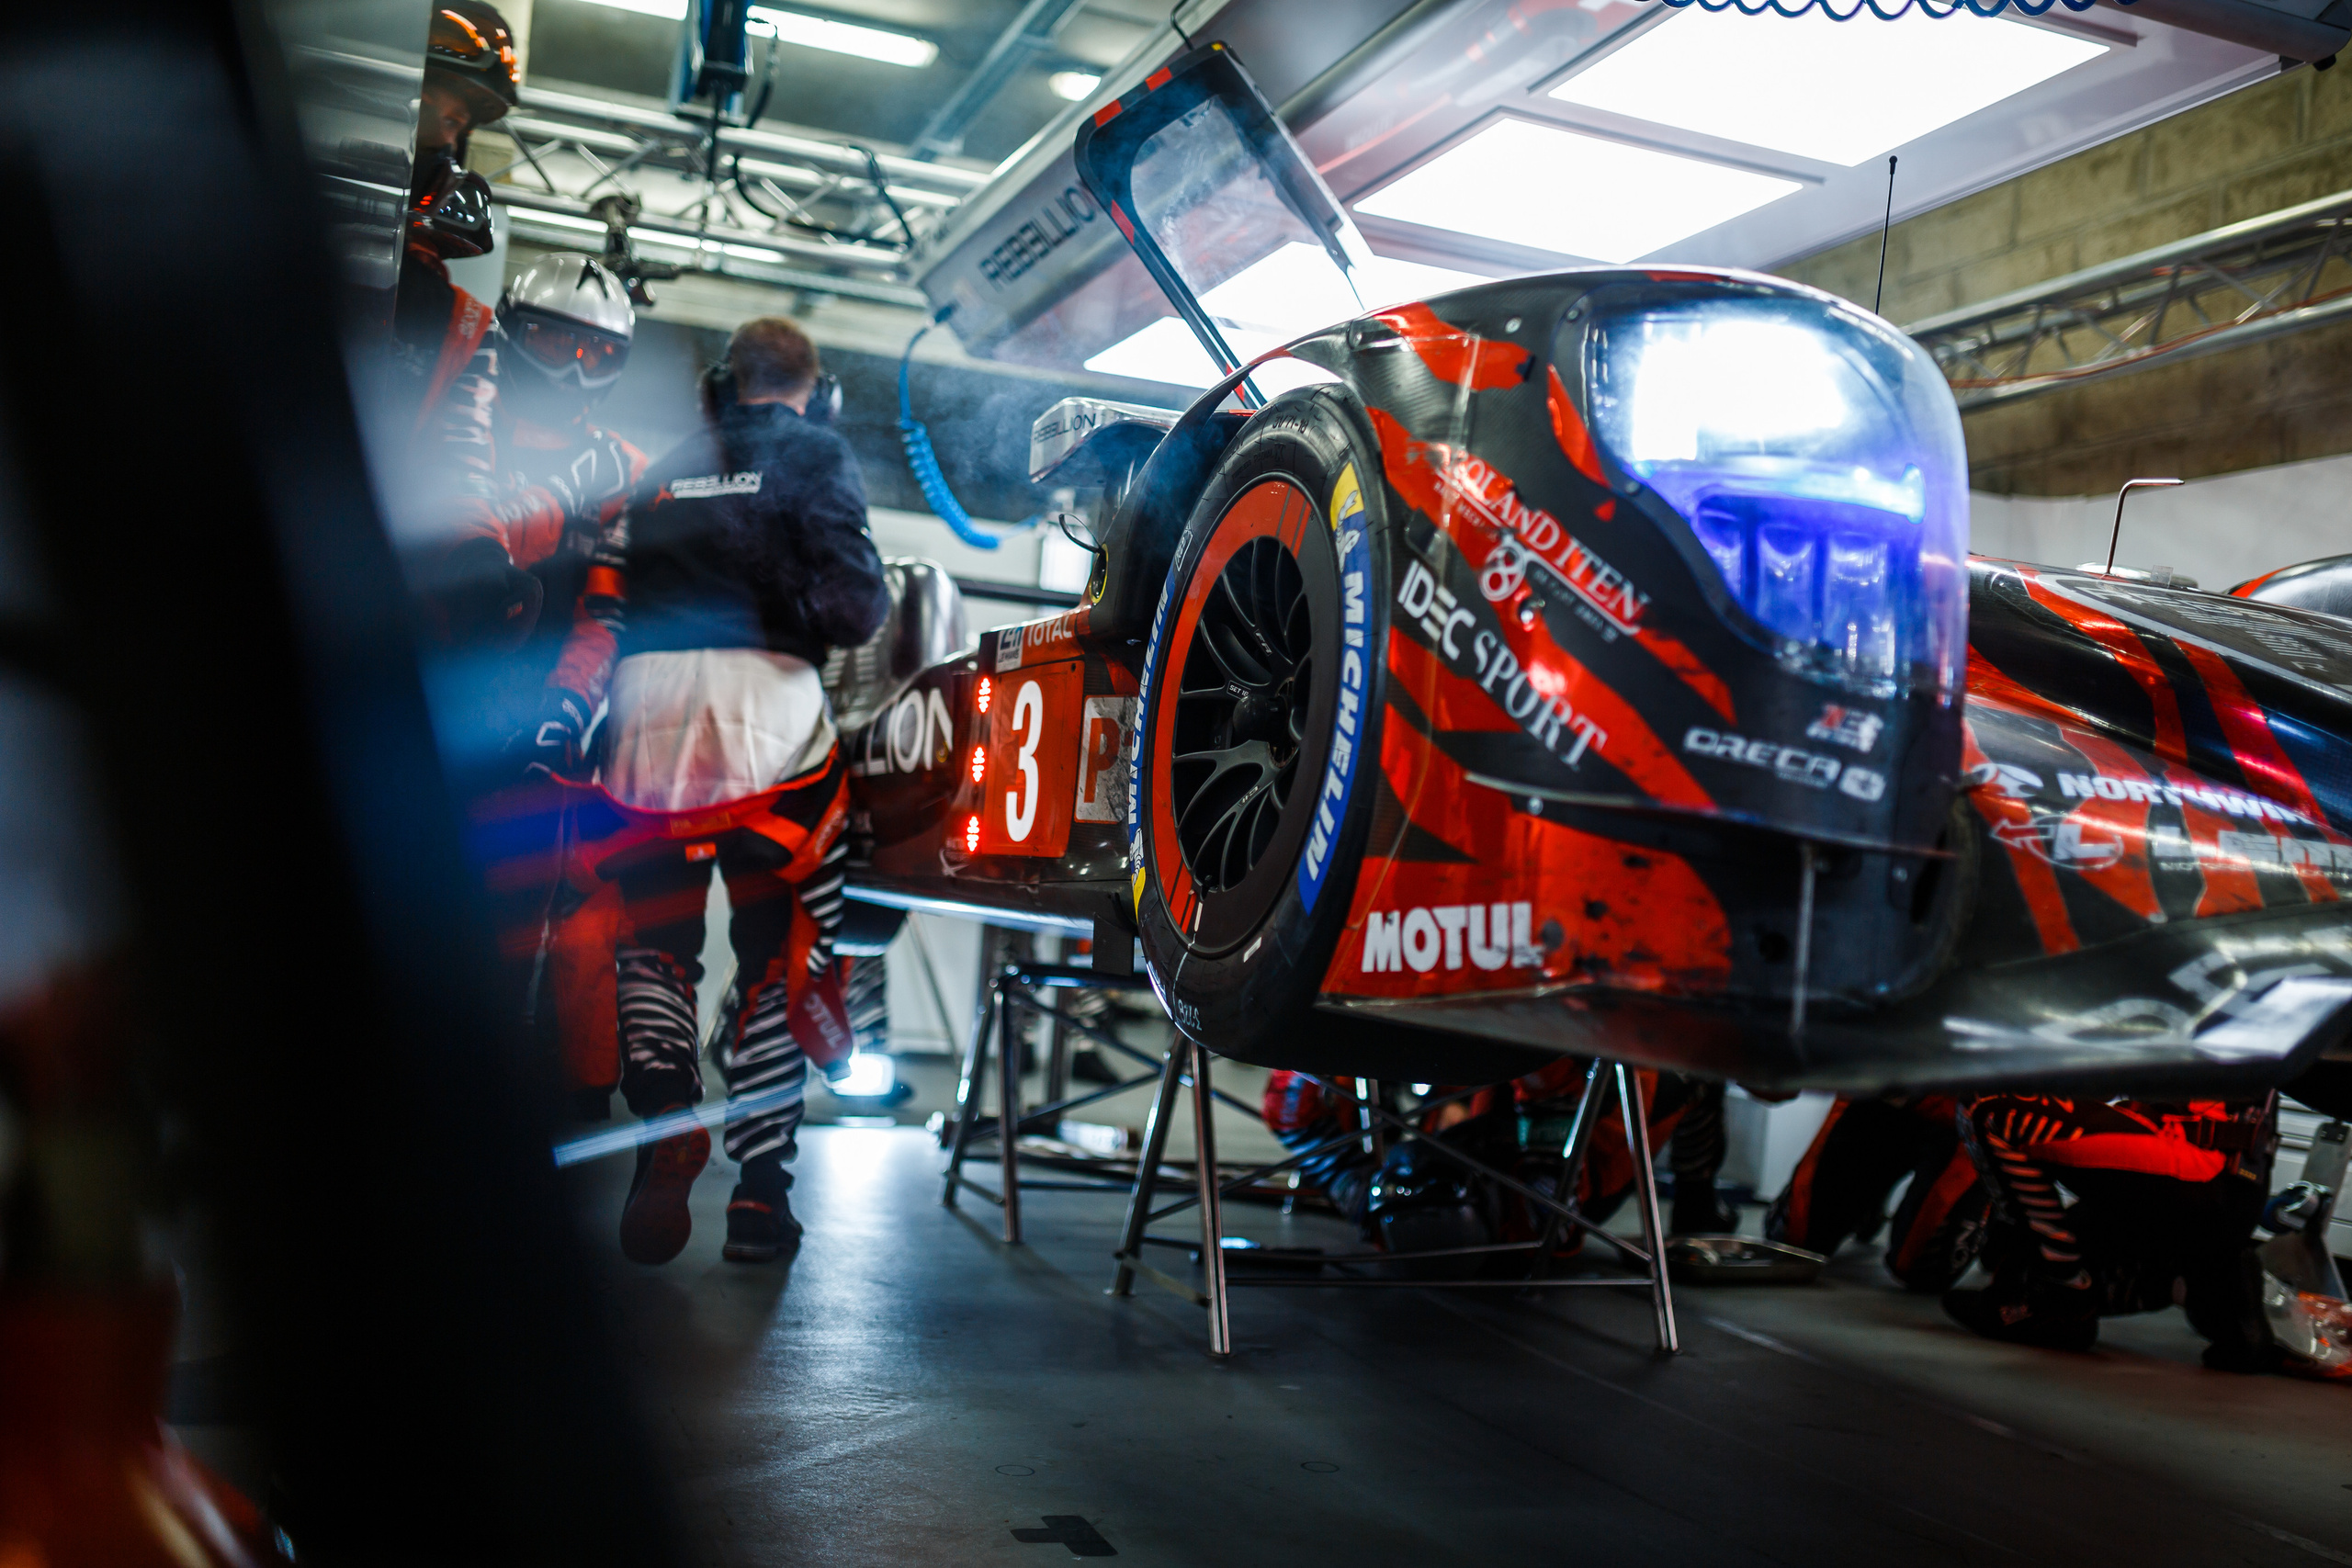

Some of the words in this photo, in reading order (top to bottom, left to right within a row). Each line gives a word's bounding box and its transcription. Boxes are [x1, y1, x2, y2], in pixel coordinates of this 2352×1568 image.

[1439, 445, 1561, 551] OLAND
[1553, 536, 1651, 620] ITEN
[1128, 578, 1169, 825] MICHELIN
[1229, 684, 1241, 694] SET
[1305, 570, 1364, 882] MICHELIN
[1396, 558, 1476, 661] IDEC
[1473, 628, 1609, 773] SPORT
[1005, 680, 1043, 842] 3
[1083, 717, 1134, 804] P
[1682, 725, 1842, 782] ORECA
[1361, 899, 1545, 974] MOTUL
